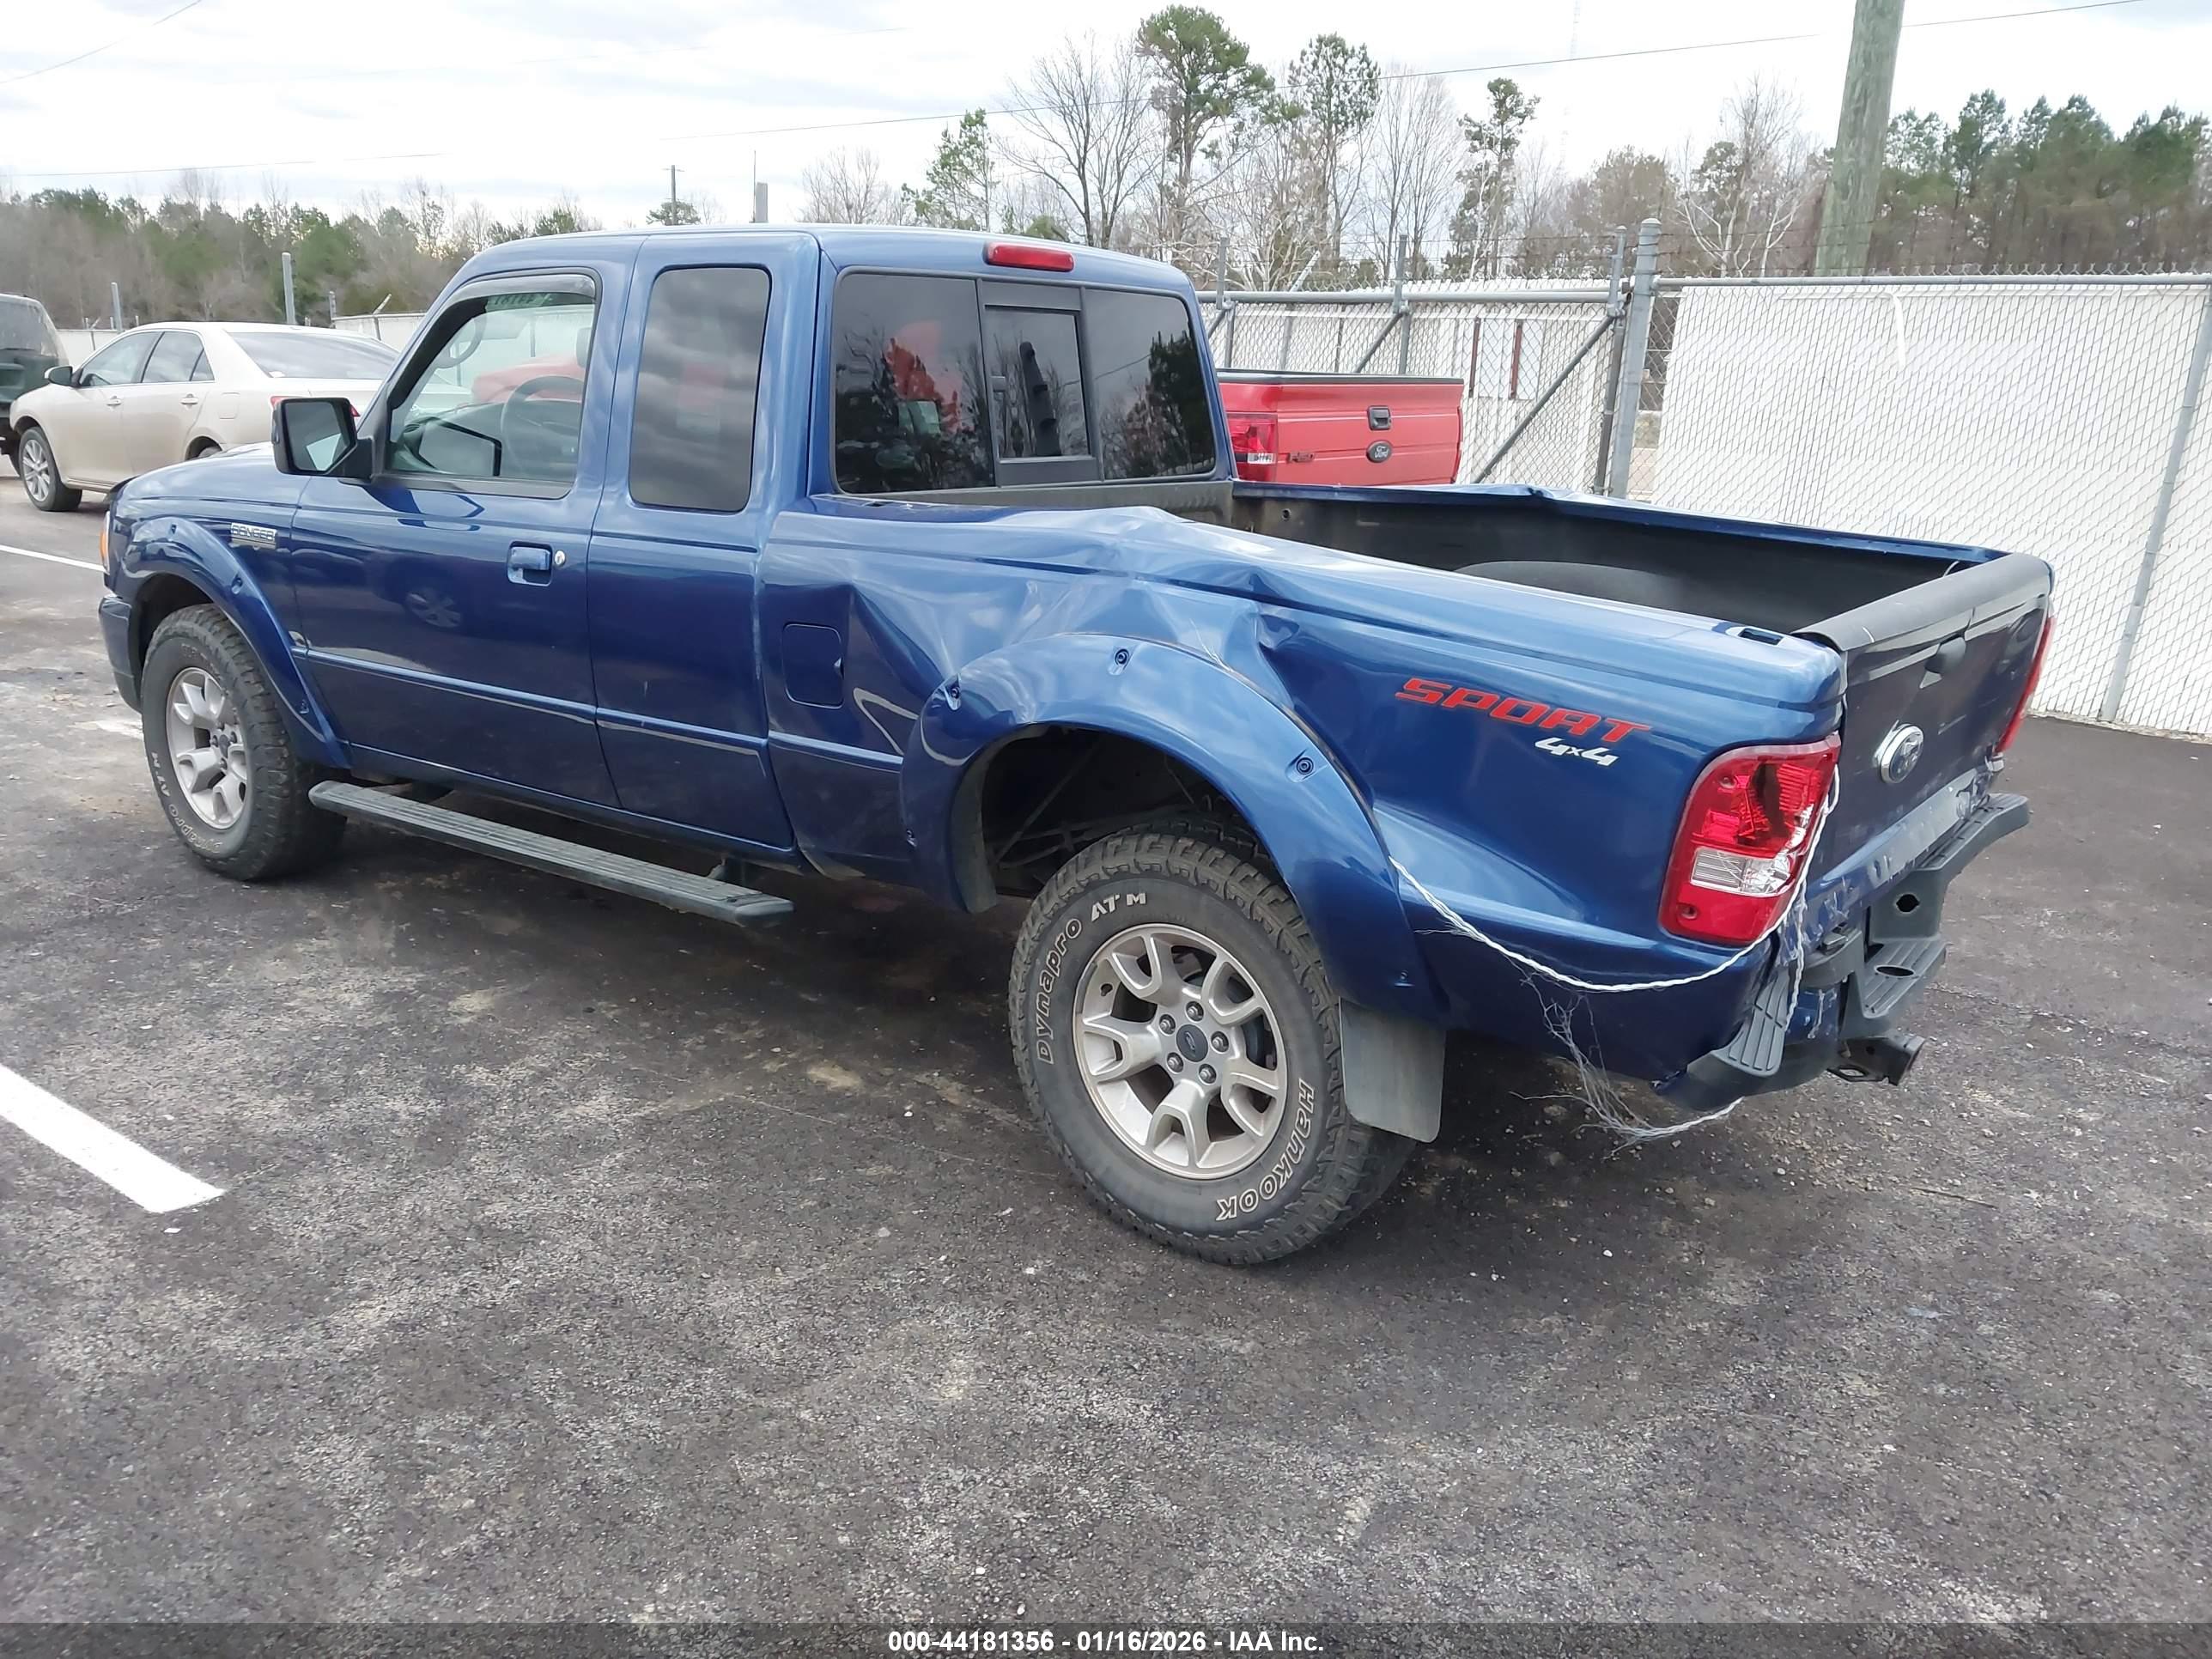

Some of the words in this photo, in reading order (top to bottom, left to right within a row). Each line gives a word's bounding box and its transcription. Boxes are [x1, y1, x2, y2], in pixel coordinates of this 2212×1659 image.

[1395, 678, 1651, 743] SPORT
[1534, 737, 1619, 766] 4x4
[1036, 918, 1082, 1065] Dynapro
